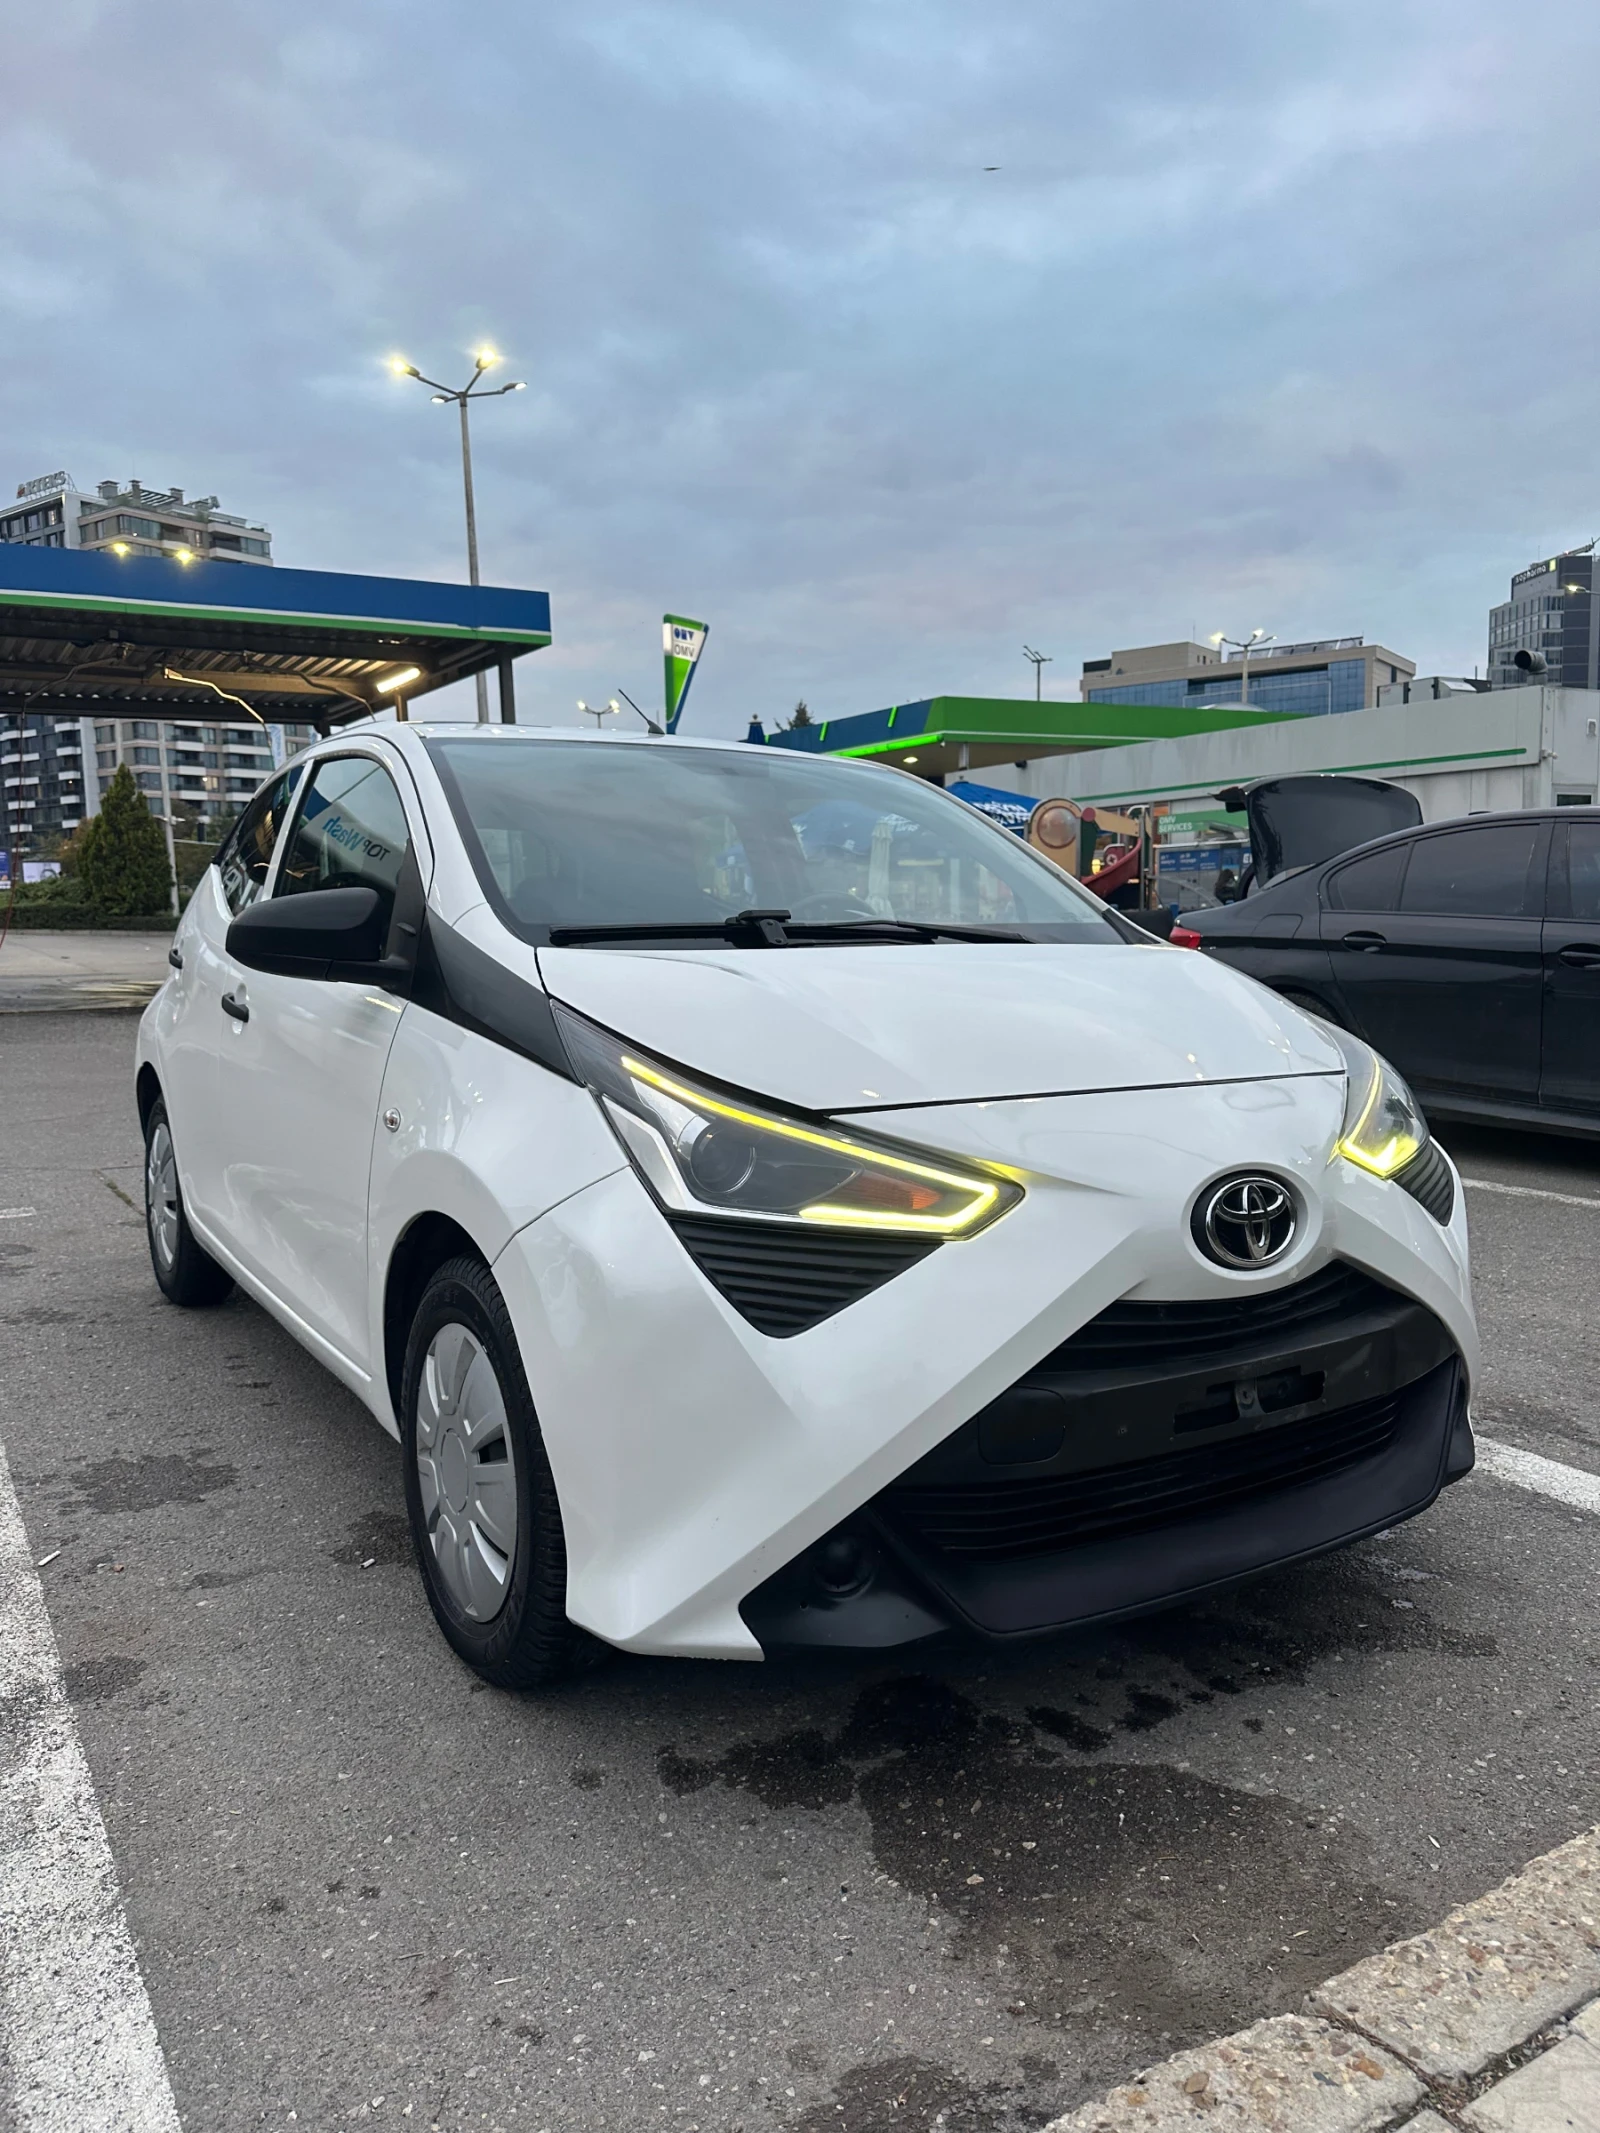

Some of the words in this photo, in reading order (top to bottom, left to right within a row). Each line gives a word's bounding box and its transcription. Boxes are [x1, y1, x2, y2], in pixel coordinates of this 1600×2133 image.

[674, 644, 695, 657] OMV
[1159, 815, 1176, 824] OMV
[1159, 822, 1192, 833] SERVICES
